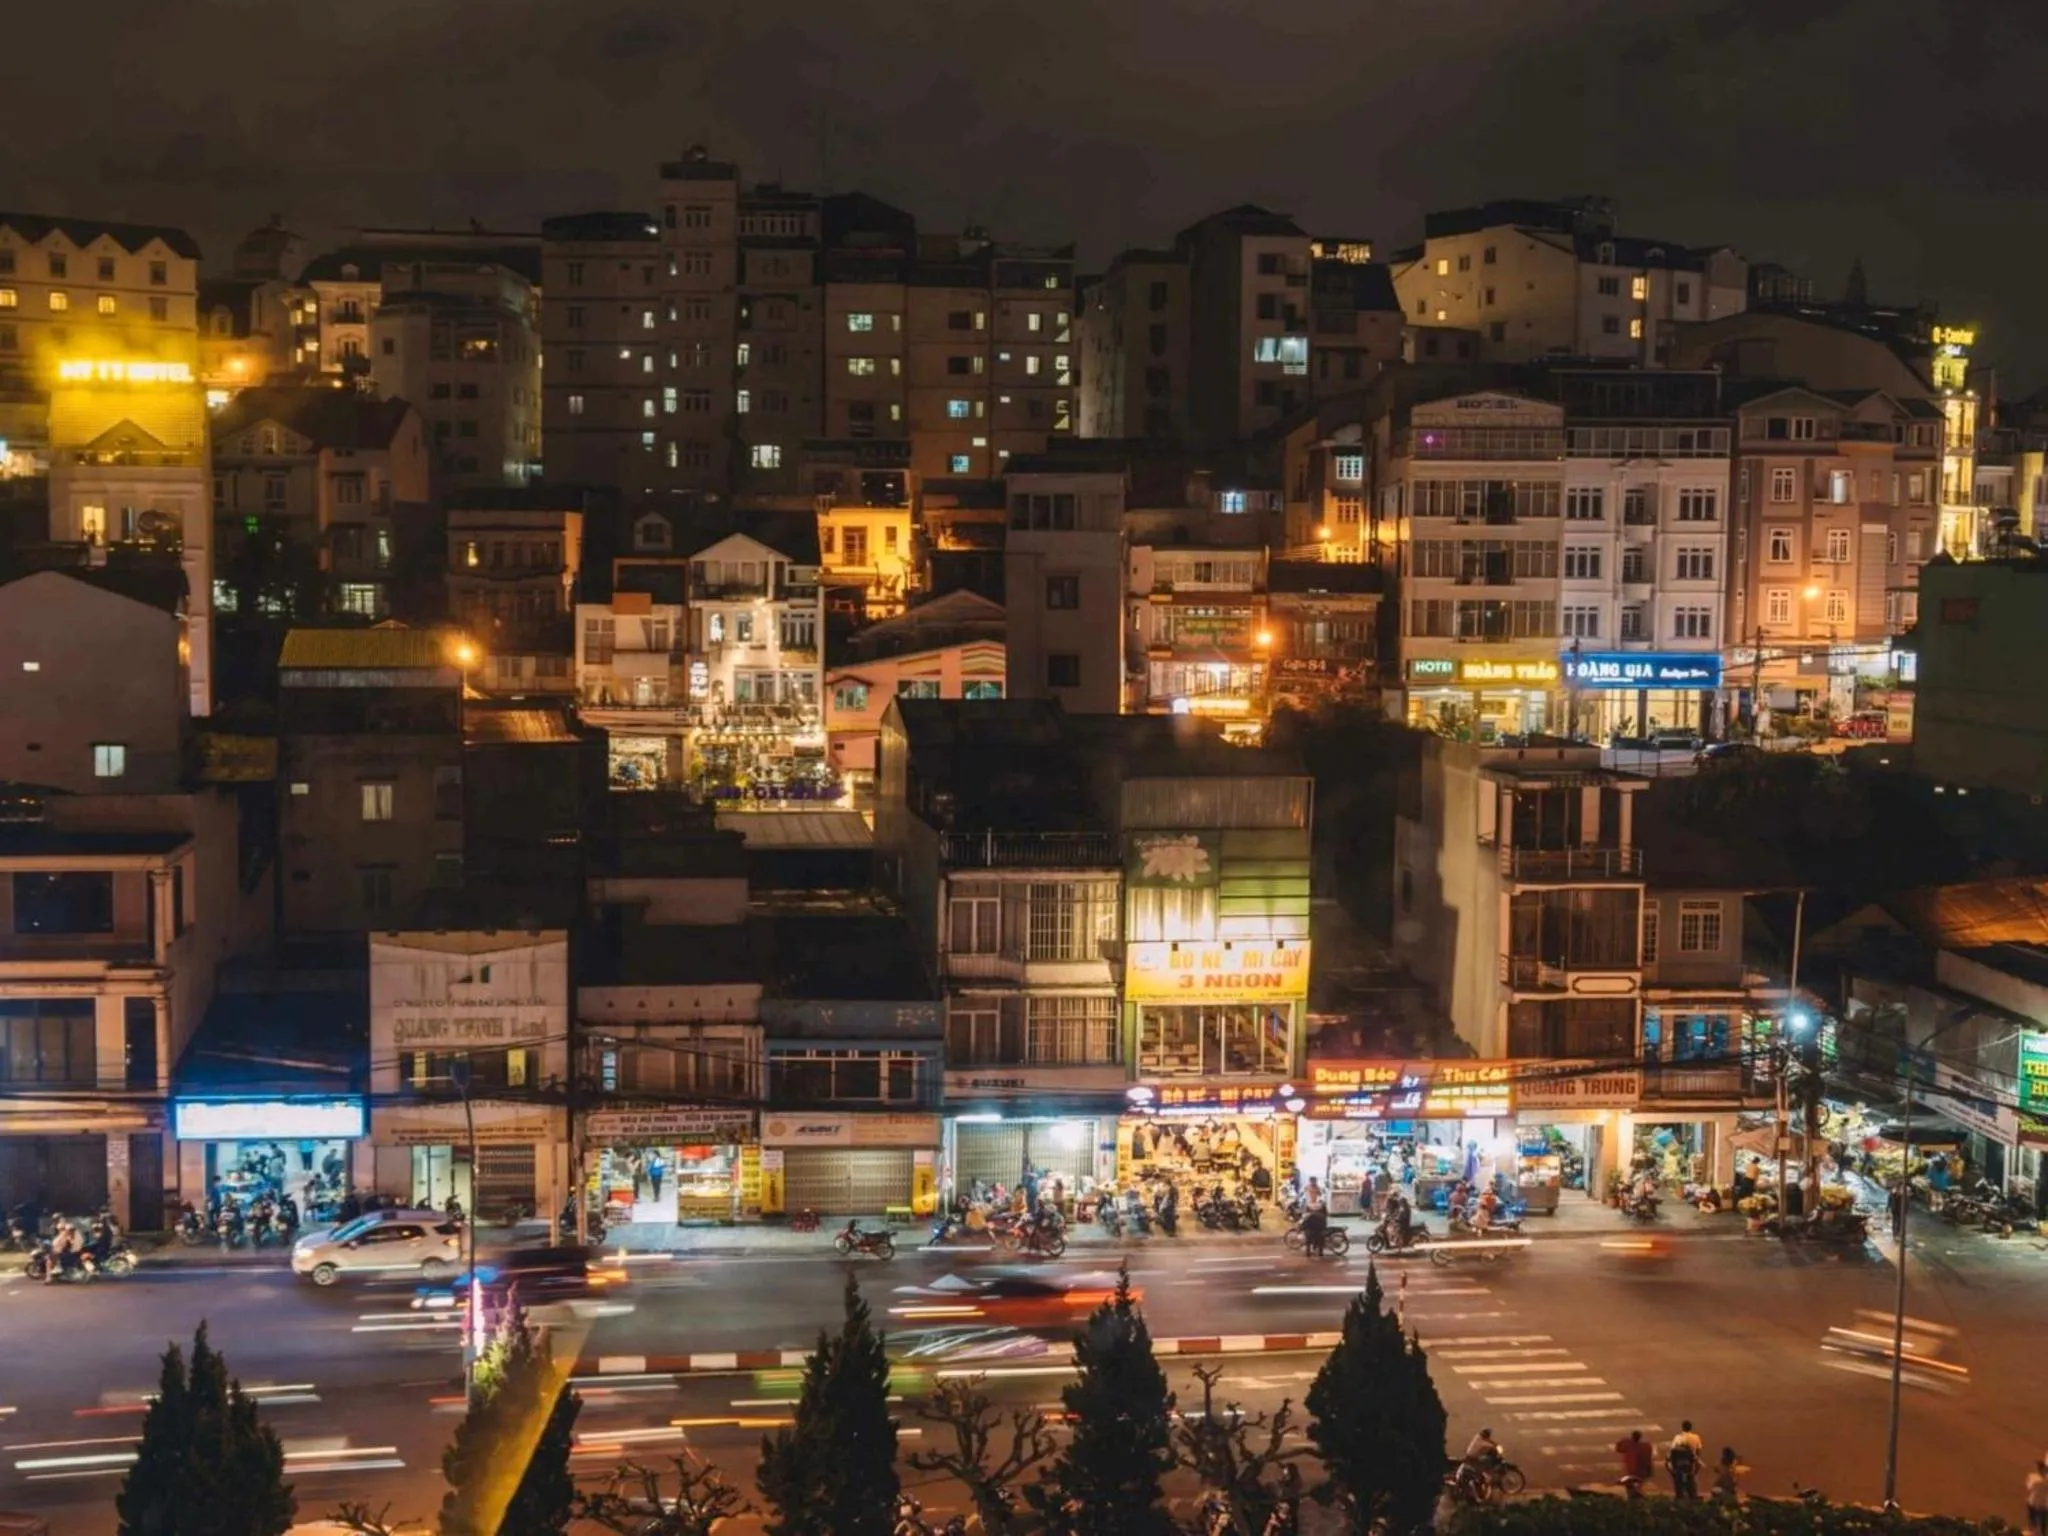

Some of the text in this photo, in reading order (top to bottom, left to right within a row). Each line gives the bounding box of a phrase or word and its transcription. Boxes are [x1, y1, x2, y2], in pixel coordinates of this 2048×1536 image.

[1415, 660, 1453, 673] HOTEL
[1179, 974, 1194, 988] 3
[1584, 1077, 1636, 1096] TRUNG
